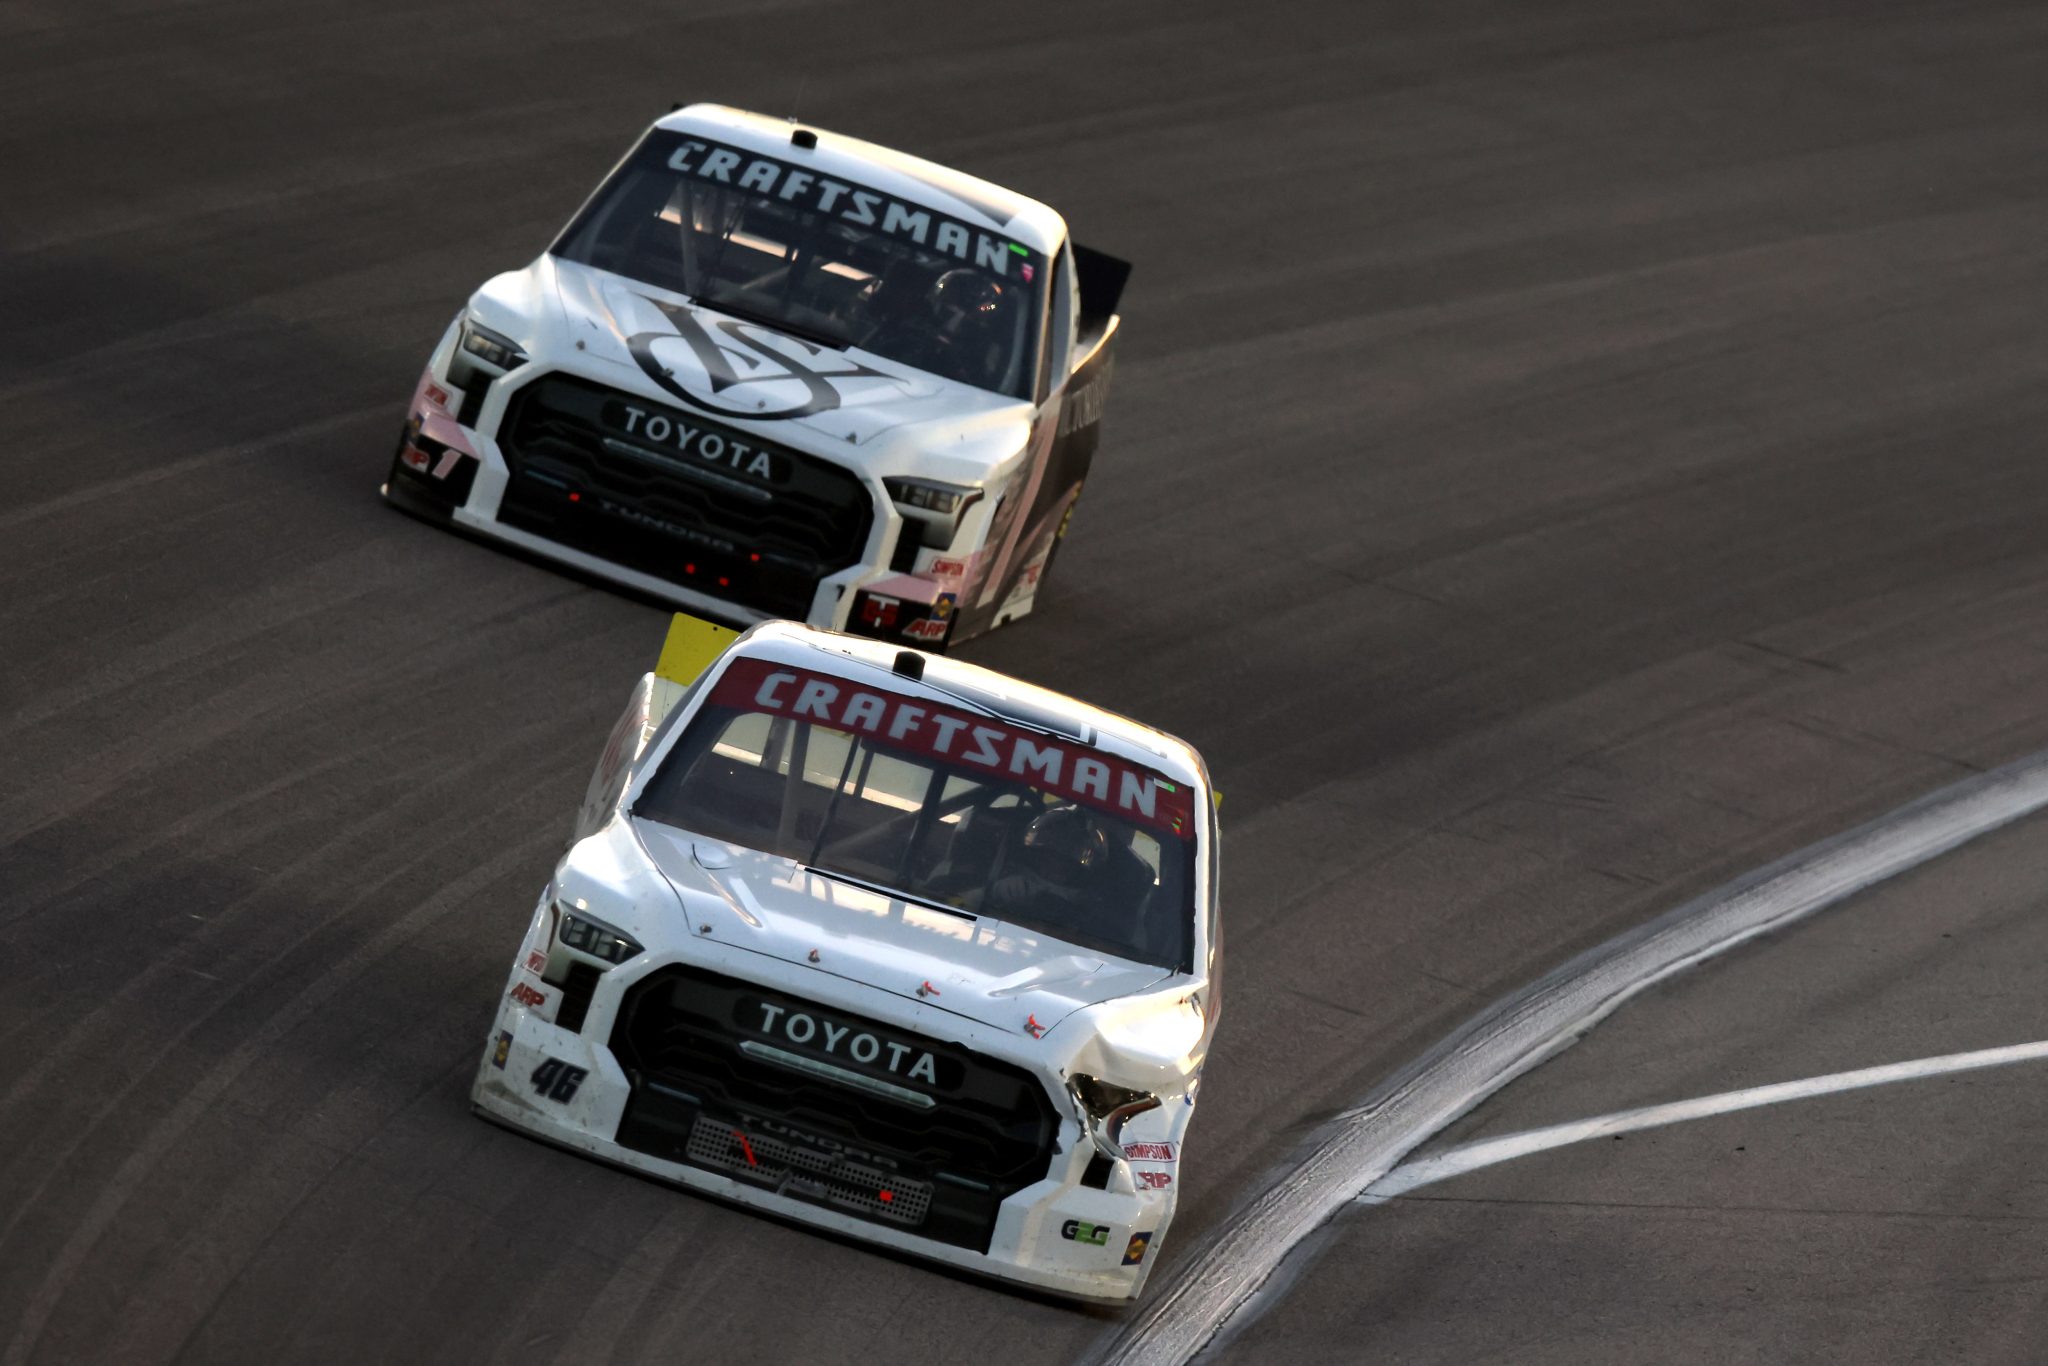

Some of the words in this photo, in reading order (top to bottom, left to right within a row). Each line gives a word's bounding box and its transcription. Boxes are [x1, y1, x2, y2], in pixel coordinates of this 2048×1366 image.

[667, 141, 1010, 276] CRAFTSMAN
[624, 406, 771, 480] TOYOTA
[755, 672, 1158, 818] CRAFTSMAN
[529, 1056, 590, 1104] 46
[760, 1002, 936, 1084] TOYOTA
[1124, 1143, 1172, 1161] SIMPSON
